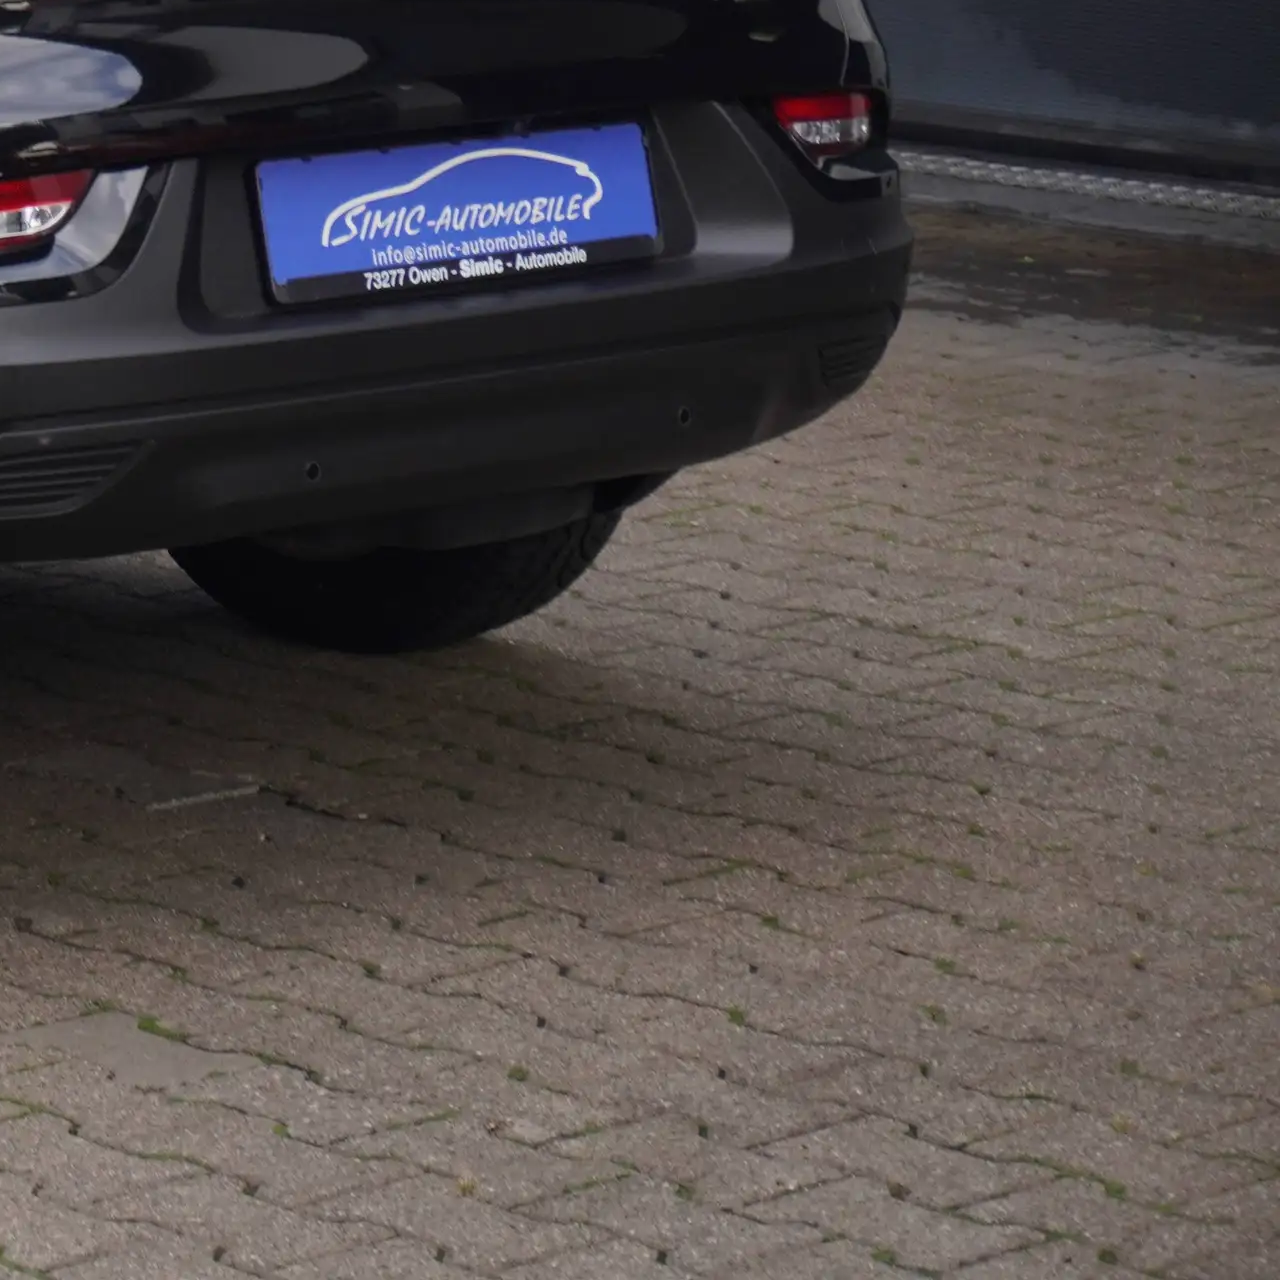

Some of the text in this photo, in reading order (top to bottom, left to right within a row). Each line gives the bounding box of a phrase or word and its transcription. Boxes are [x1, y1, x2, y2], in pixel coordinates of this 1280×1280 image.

[330, 193, 584, 247] SIMIC-AUTOMOBILE
[363, 267, 406, 291] 73277
[408, 266, 449, 285] Owen
[459, 256, 504, 279] Simic
[515, 245, 588, 272] Automobile
[371, 225, 568, 267] info@simic-automobile.de
